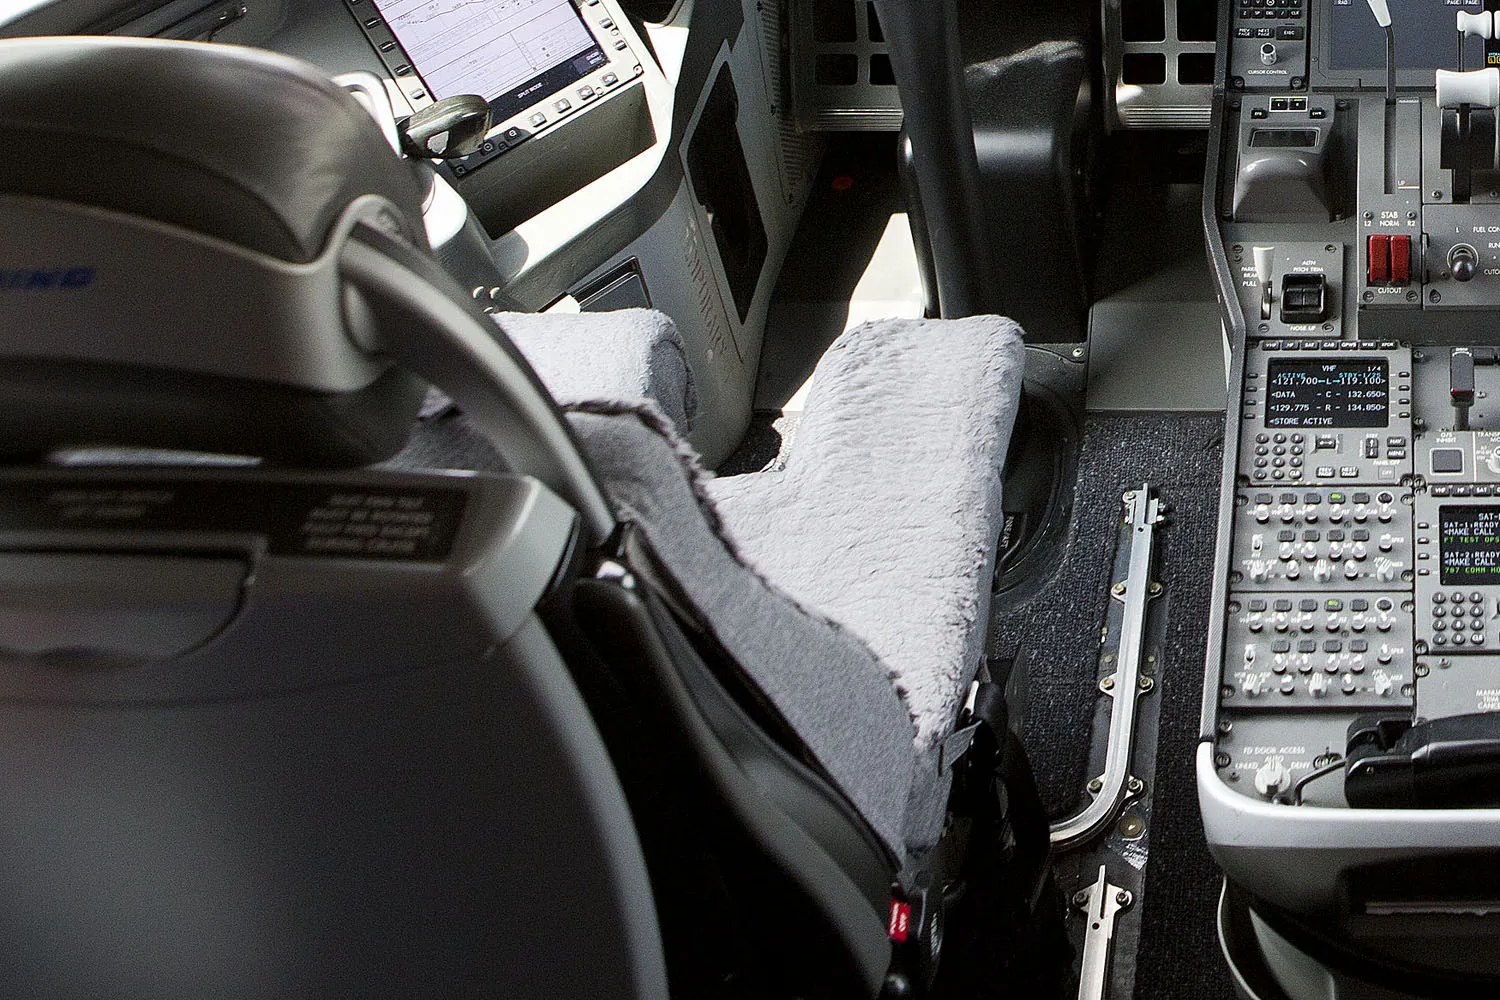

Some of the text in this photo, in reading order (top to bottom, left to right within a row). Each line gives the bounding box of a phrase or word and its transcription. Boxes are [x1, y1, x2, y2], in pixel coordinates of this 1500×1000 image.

[1381, 211, 1398, 219] STAB
[1303, 417, 1333, 425] ACTIVE
[1473, 528, 1495, 536] CALL
[1474, 558, 1496, 566] CALL
[1465, 566, 1487, 574] COMM
